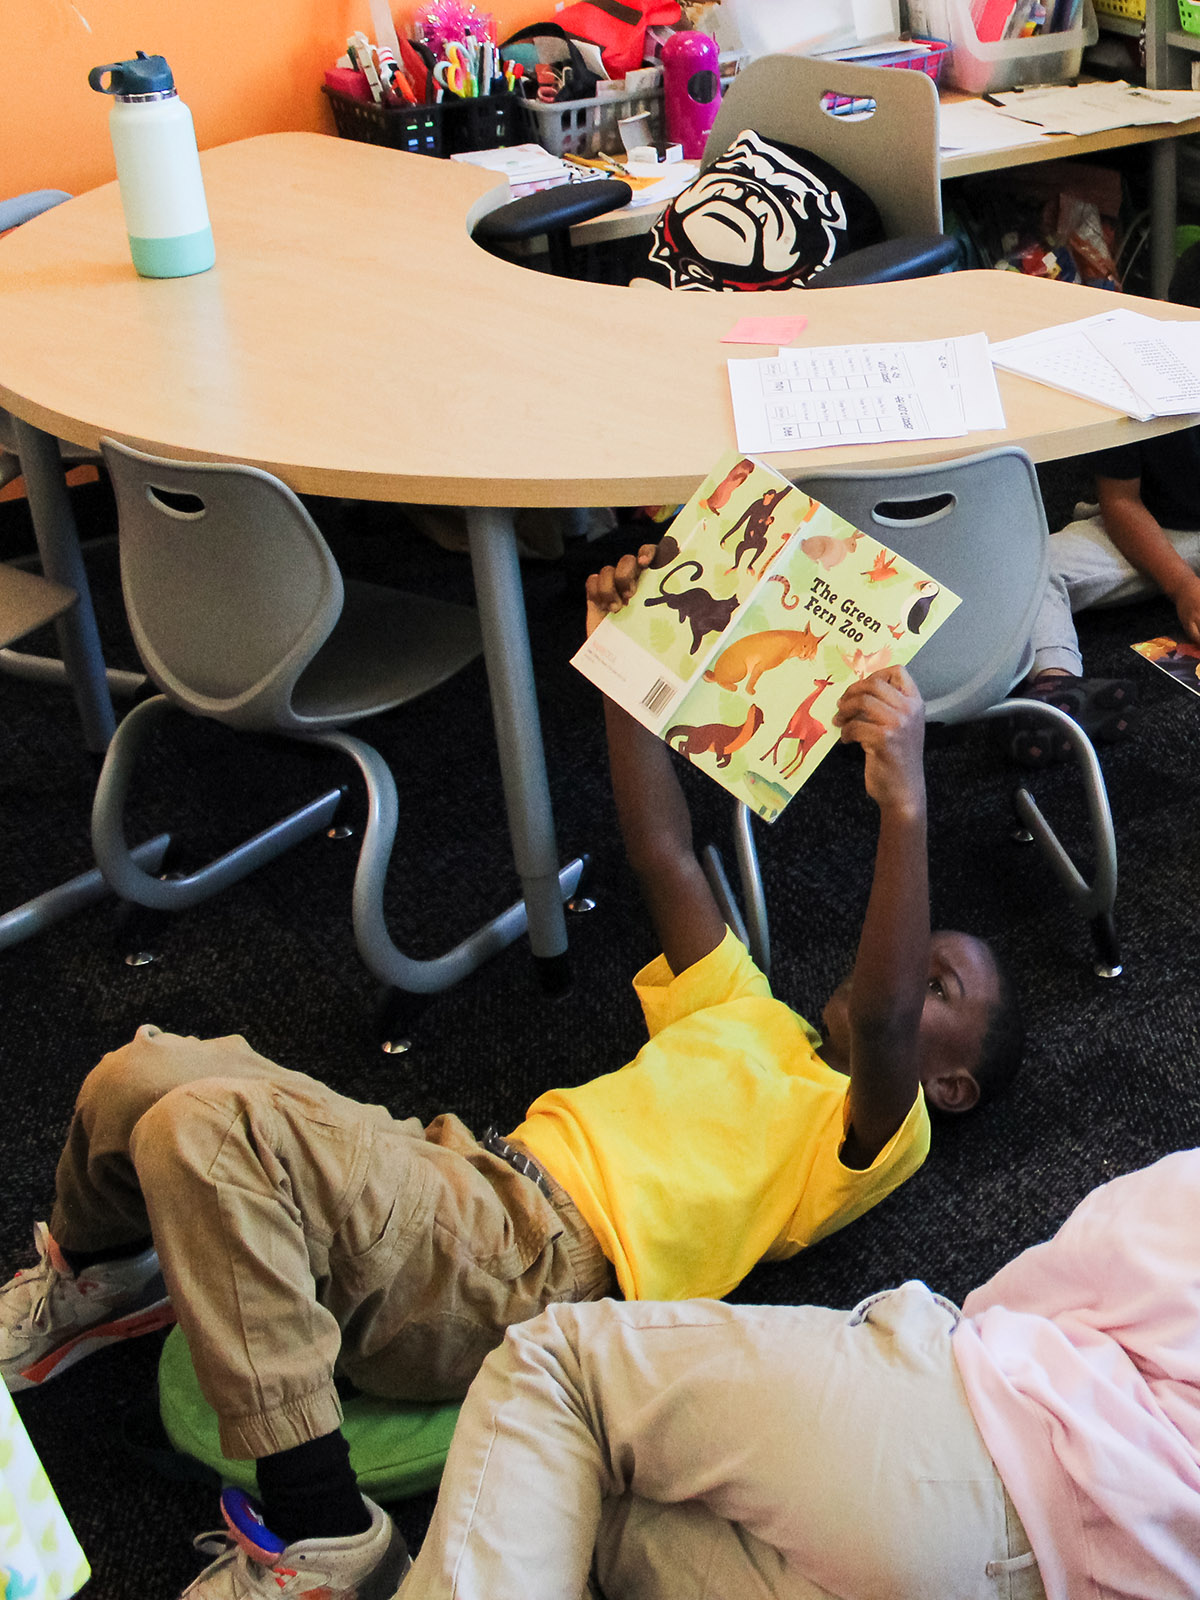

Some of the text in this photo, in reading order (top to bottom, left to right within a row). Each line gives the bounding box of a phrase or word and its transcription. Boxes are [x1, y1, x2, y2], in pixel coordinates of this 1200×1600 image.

[804, 596, 864, 643] Fern Zoo
[810, 577, 881, 633] The Green
